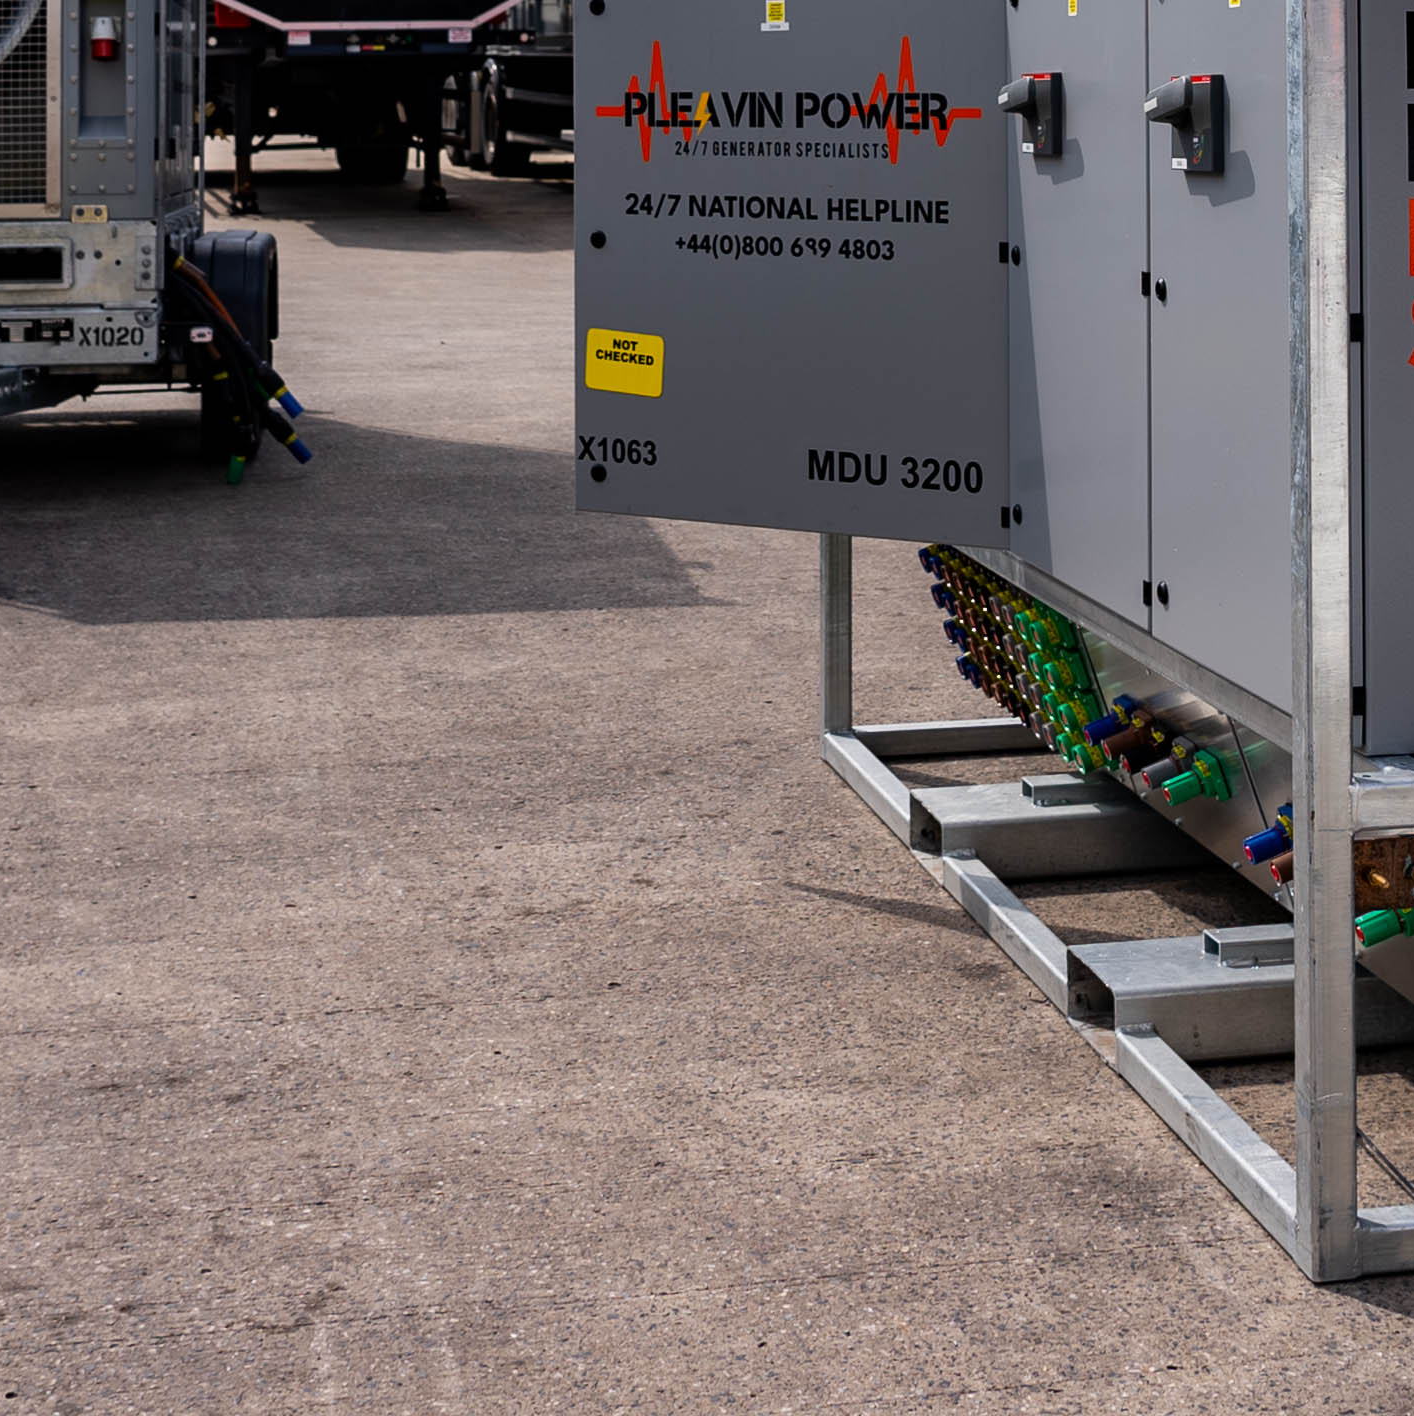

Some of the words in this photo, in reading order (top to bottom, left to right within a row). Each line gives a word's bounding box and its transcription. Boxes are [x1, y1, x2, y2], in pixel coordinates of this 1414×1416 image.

[624, 91, 783, 129] PLEAVIN
[795, 92, 949, 131] POWER
[674, 141, 708, 157] 24/7
[712, 141, 791, 157] GENERATOR
[795, 142, 889, 159] SPECIALISTS
[625, 192, 681, 219] 24/7
[688, 194, 818, 221] NATIONAL
[826, 197, 949, 224] HELPLINE
[675, 234, 784, 261] +44(0)800
[838, 239, 895, 261] 4803
[78, 325, 145, 347] X1020
[612, 339, 638, 352] NOT
[595, 349, 655, 366] CHECKED
[578, 435, 658, 466] X1063
[808, 449, 888, 486] MDU
[900, 456, 984, 494] 3200
